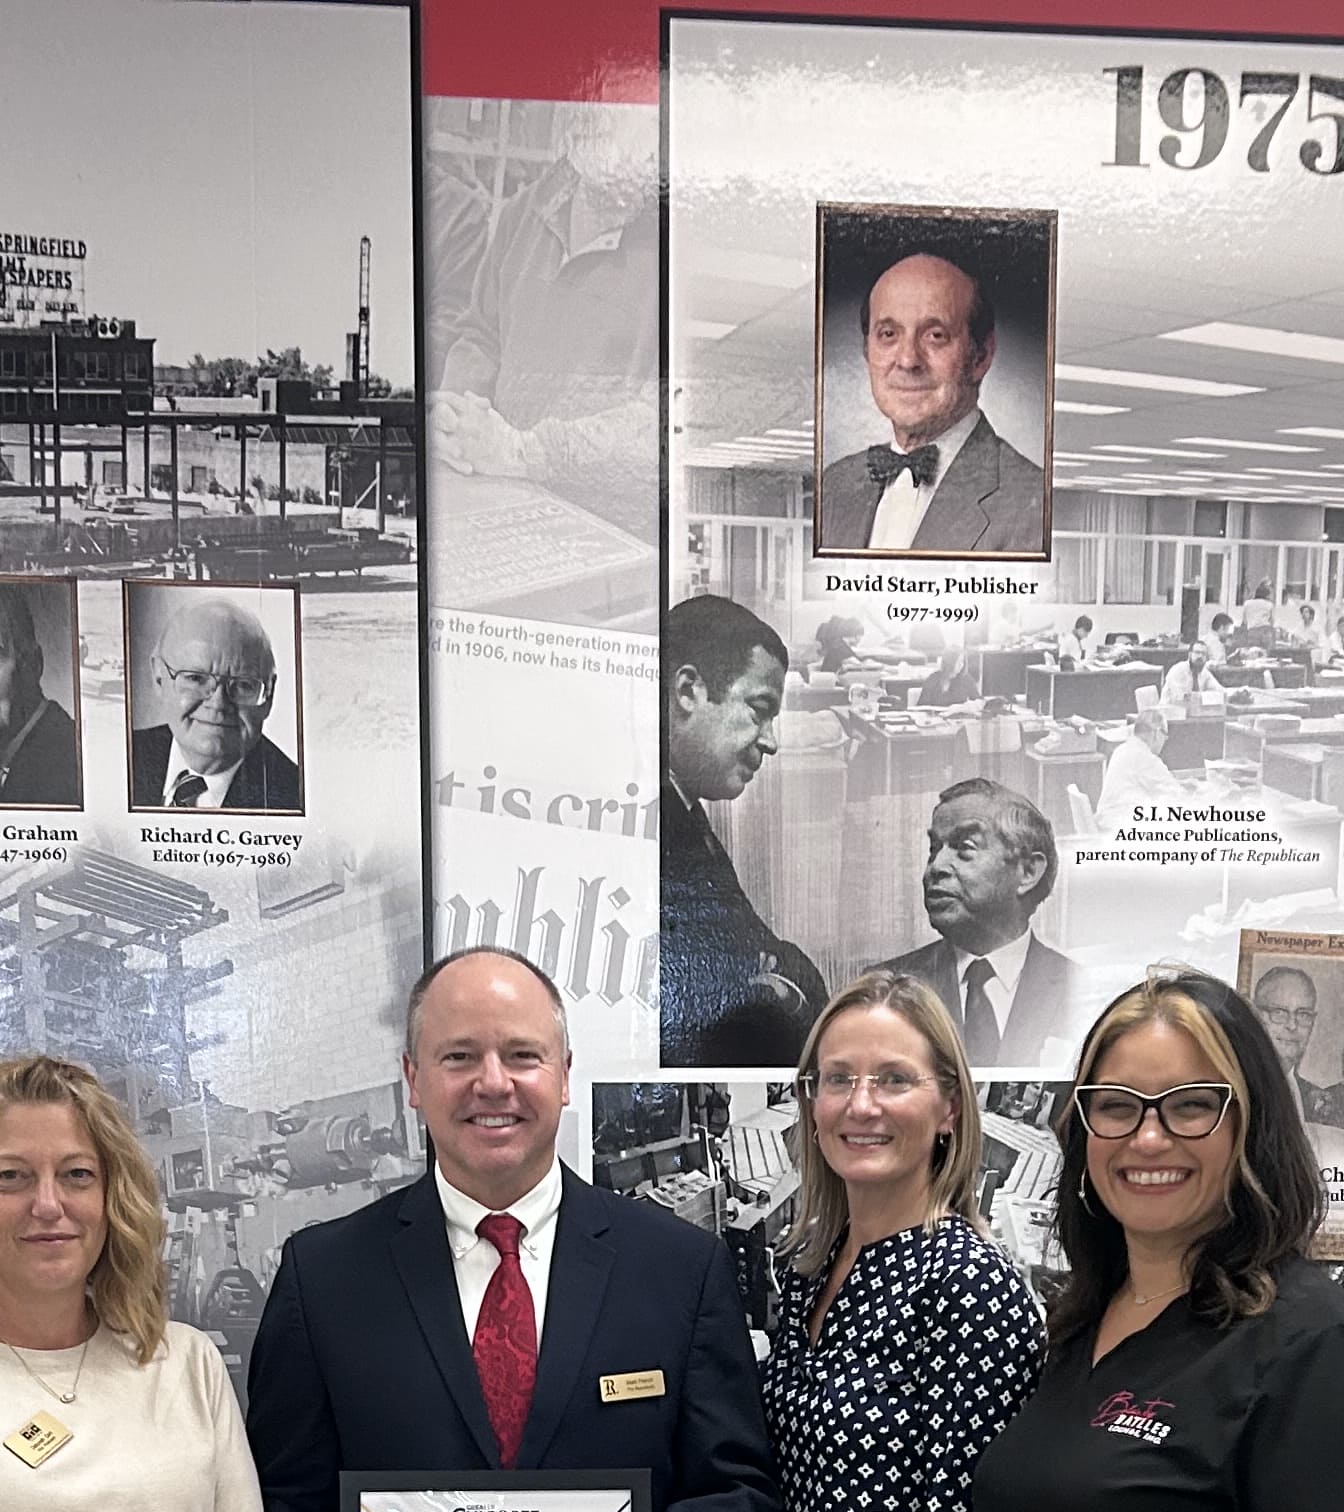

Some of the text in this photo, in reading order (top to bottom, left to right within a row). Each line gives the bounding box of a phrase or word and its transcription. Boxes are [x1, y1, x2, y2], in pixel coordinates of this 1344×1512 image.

[825, 574, 1039, 597] David Starr, Publisher
[886, 602, 980, 622] (1977-1999)
[449, 617, 622, 653] the fourth-generation
[465, 642, 601, 673] 1906, now has its
[1132, 806, 1266, 823] S.I. Newhouse
[2, 825, 79, 842] Graham
[140, 827, 303, 852] Richard C. Garvey
[1115, 828, 1284, 845] Advance Publications,
[152, 849, 292, 869] Editor (1967-1986)
[1075, 848, 1321, 866] parent company of The Republican
[1256, 931, 1324, 948] Newspaper
